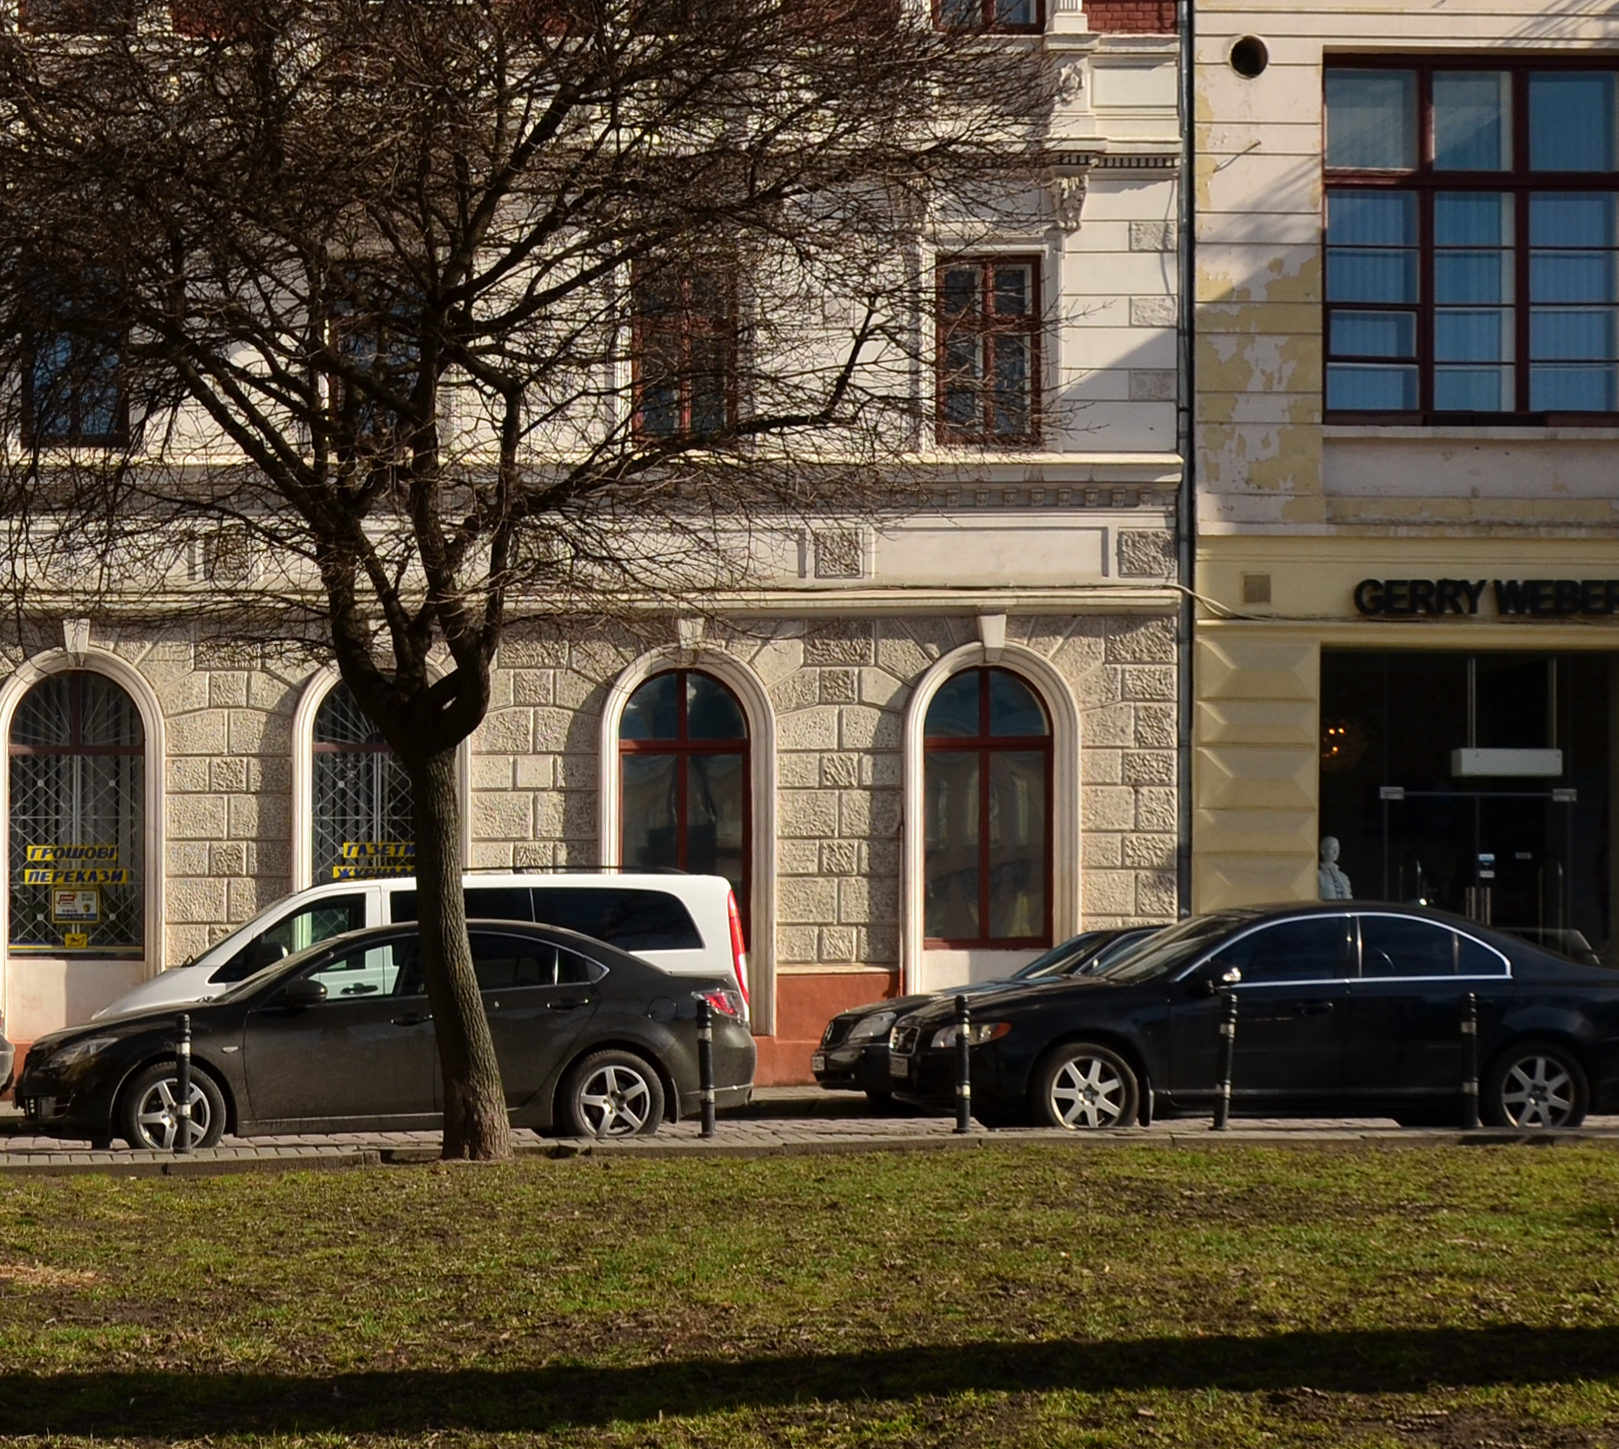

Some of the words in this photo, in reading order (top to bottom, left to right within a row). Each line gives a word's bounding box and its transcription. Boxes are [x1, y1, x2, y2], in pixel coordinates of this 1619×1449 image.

[1354, 579, 1486, 615] GERRY
[30, 847, 116, 859] ГРОШОВІ
[27, 871, 123, 883] ПЕРЕКАЗИ
